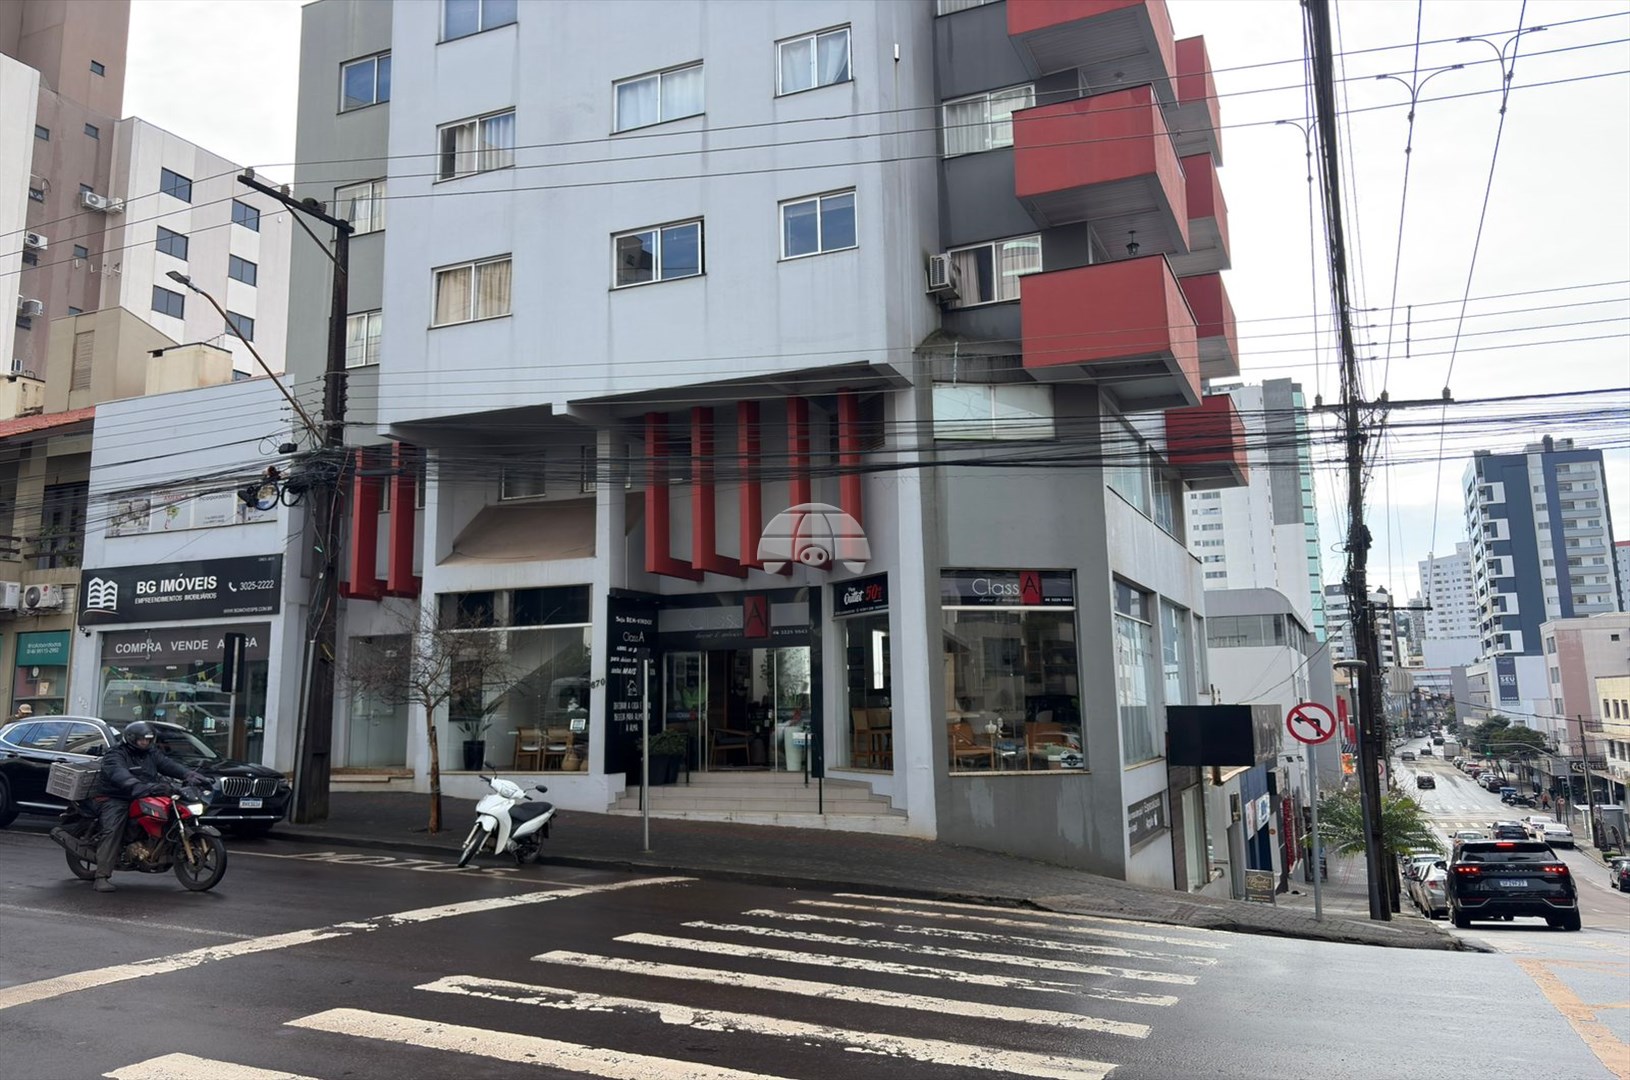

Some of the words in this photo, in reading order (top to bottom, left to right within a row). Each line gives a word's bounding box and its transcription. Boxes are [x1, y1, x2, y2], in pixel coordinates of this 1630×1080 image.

[136, 580, 157, 595] BG
[160, 573, 218, 594] IMÓVEIS
[239, 580, 275, 591] 3025-2222
[972, 578, 1020, 596] Class
[1022, 575, 1039, 595] A
[134, 594, 183, 605] EMPREENDIMENTOS
[183, 592, 217, 601] IMOBILIÁRIOS
[746, 601, 765, 627] A
[115, 641, 163, 654] COMPRA
[170, 640, 209, 651] VENDE
[217, 637, 258, 649] AGA
